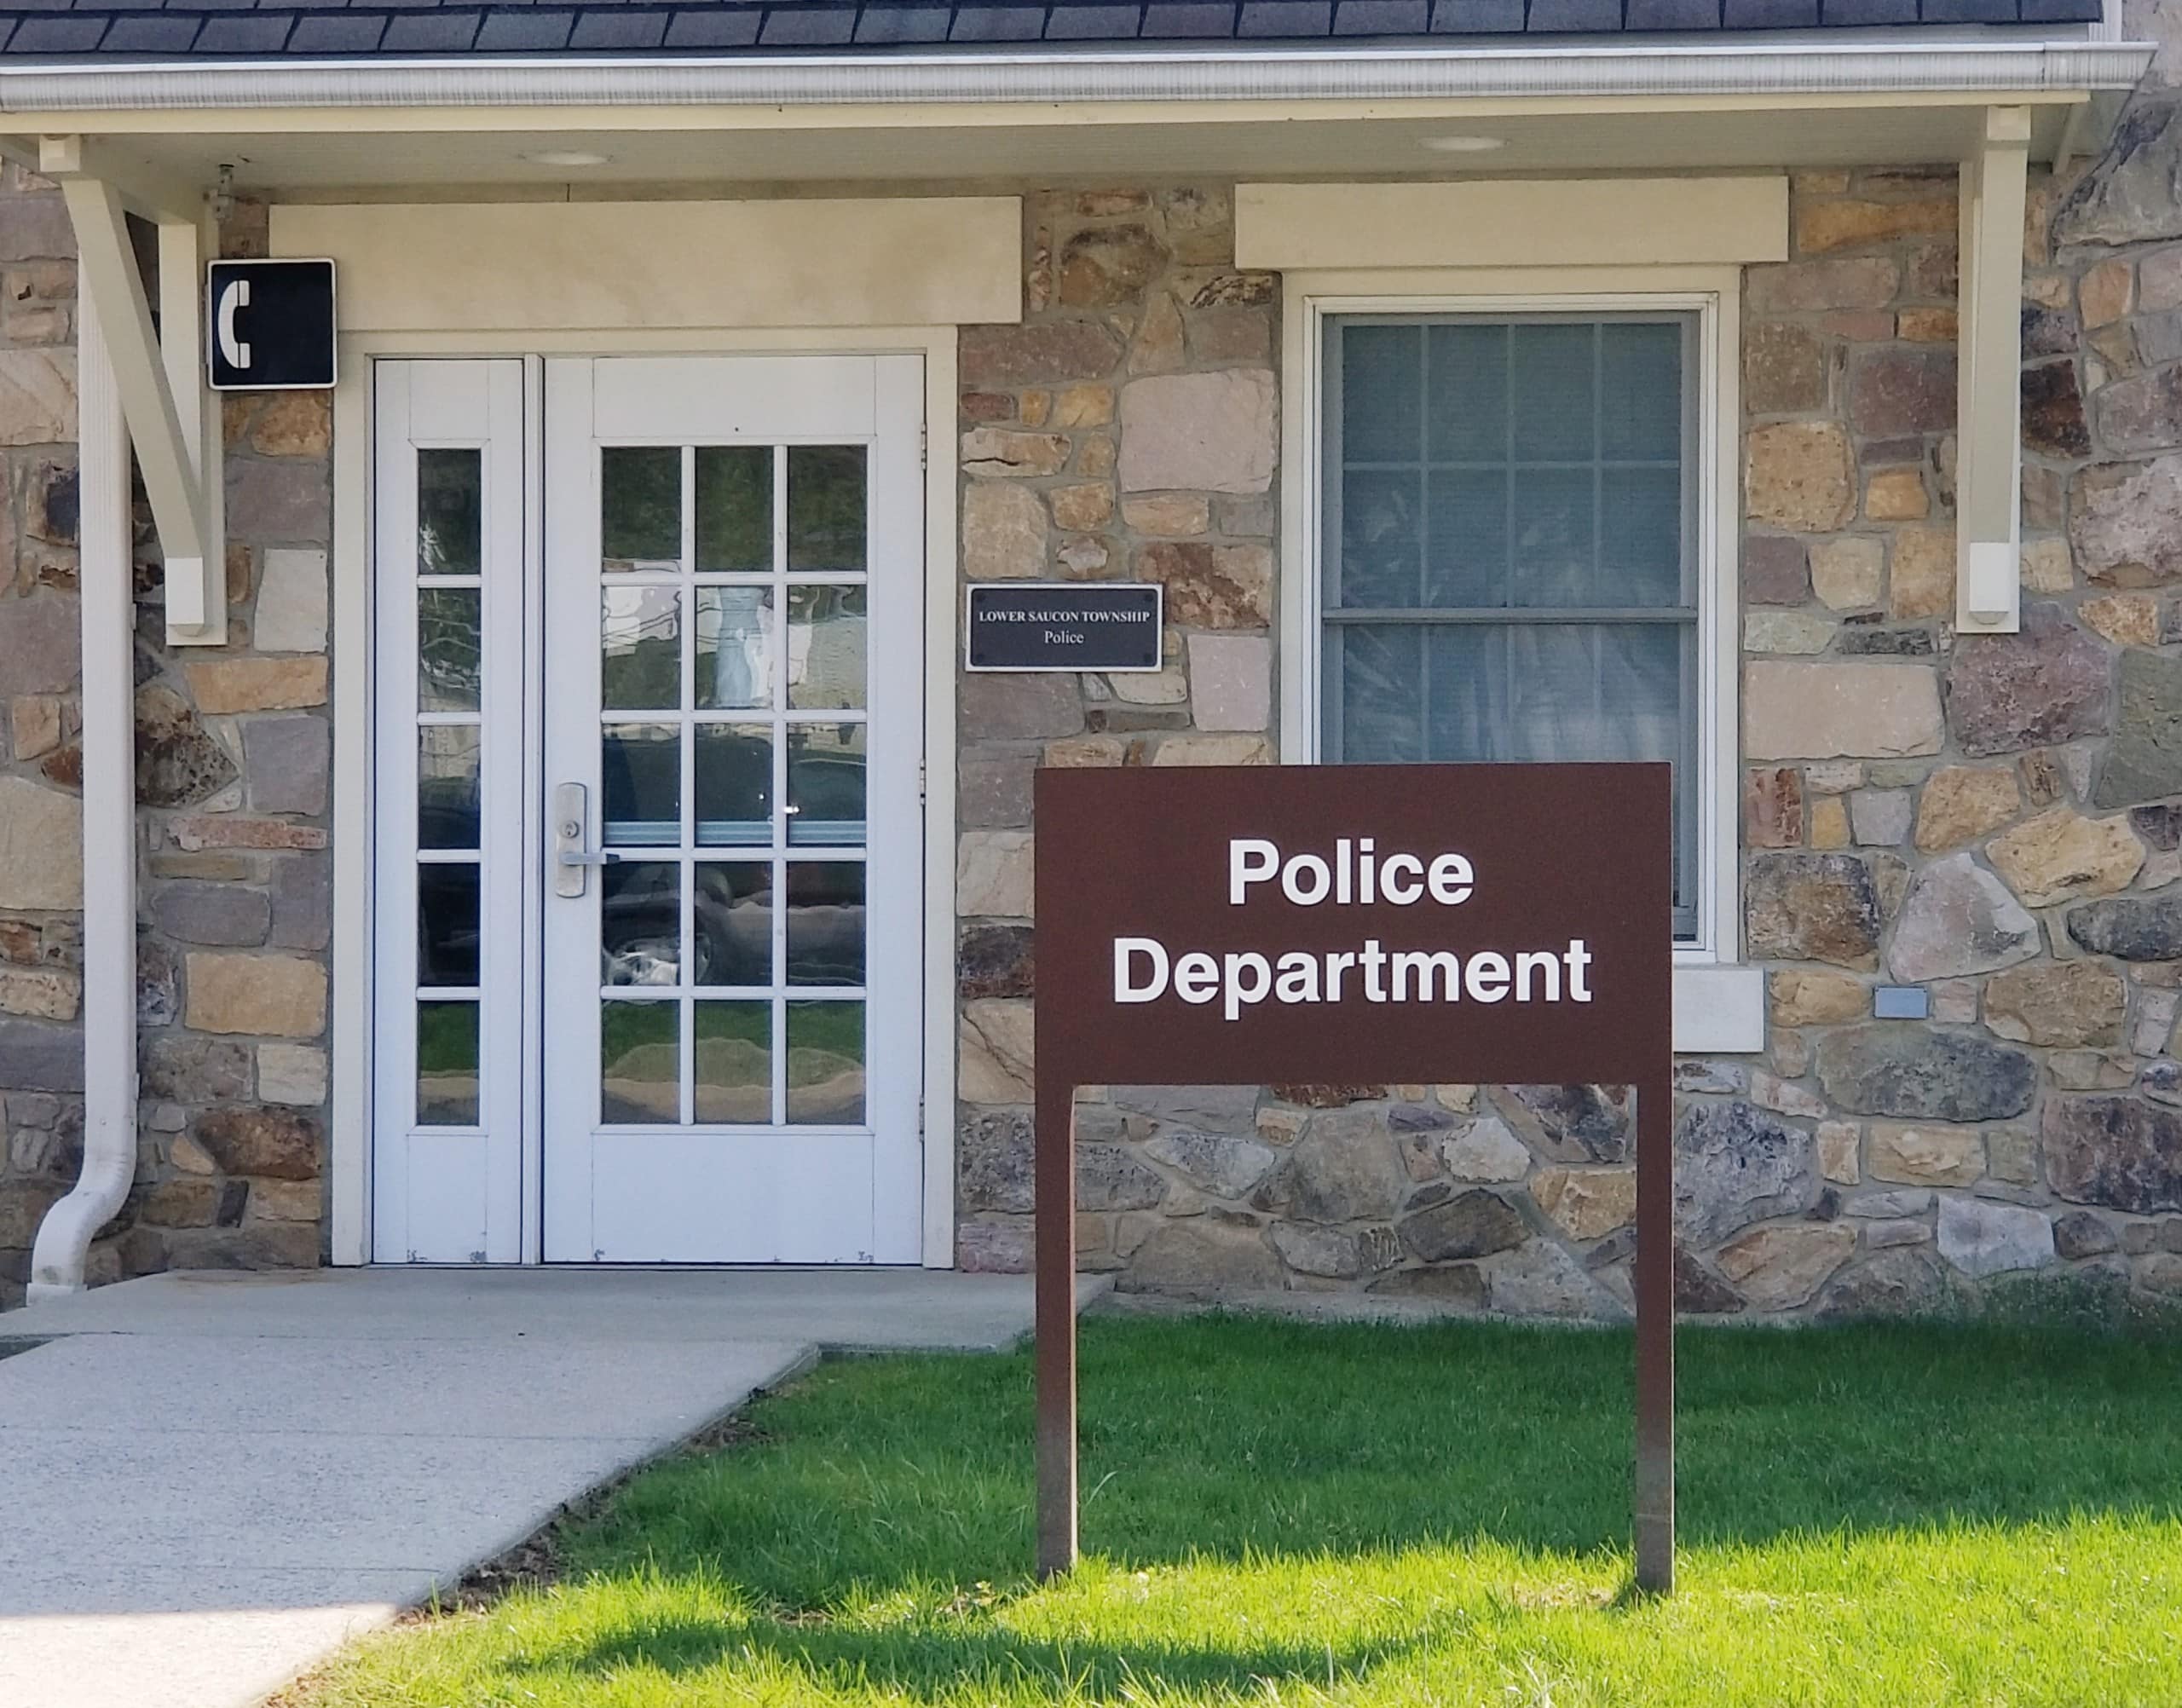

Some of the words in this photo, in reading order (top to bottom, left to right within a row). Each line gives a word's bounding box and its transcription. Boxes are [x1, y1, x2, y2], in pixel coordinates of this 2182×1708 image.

[978, 611, 1026, 622] LOWER
[1028, 611, 1079, 622] SAUCON
[1081, 611, 1151, 622] TOWNSHIP
[1044, 630, 1084, 643] Police
[1230, 838, 1474, 905] Police
[1114, 938, 1592, 1021] Department
